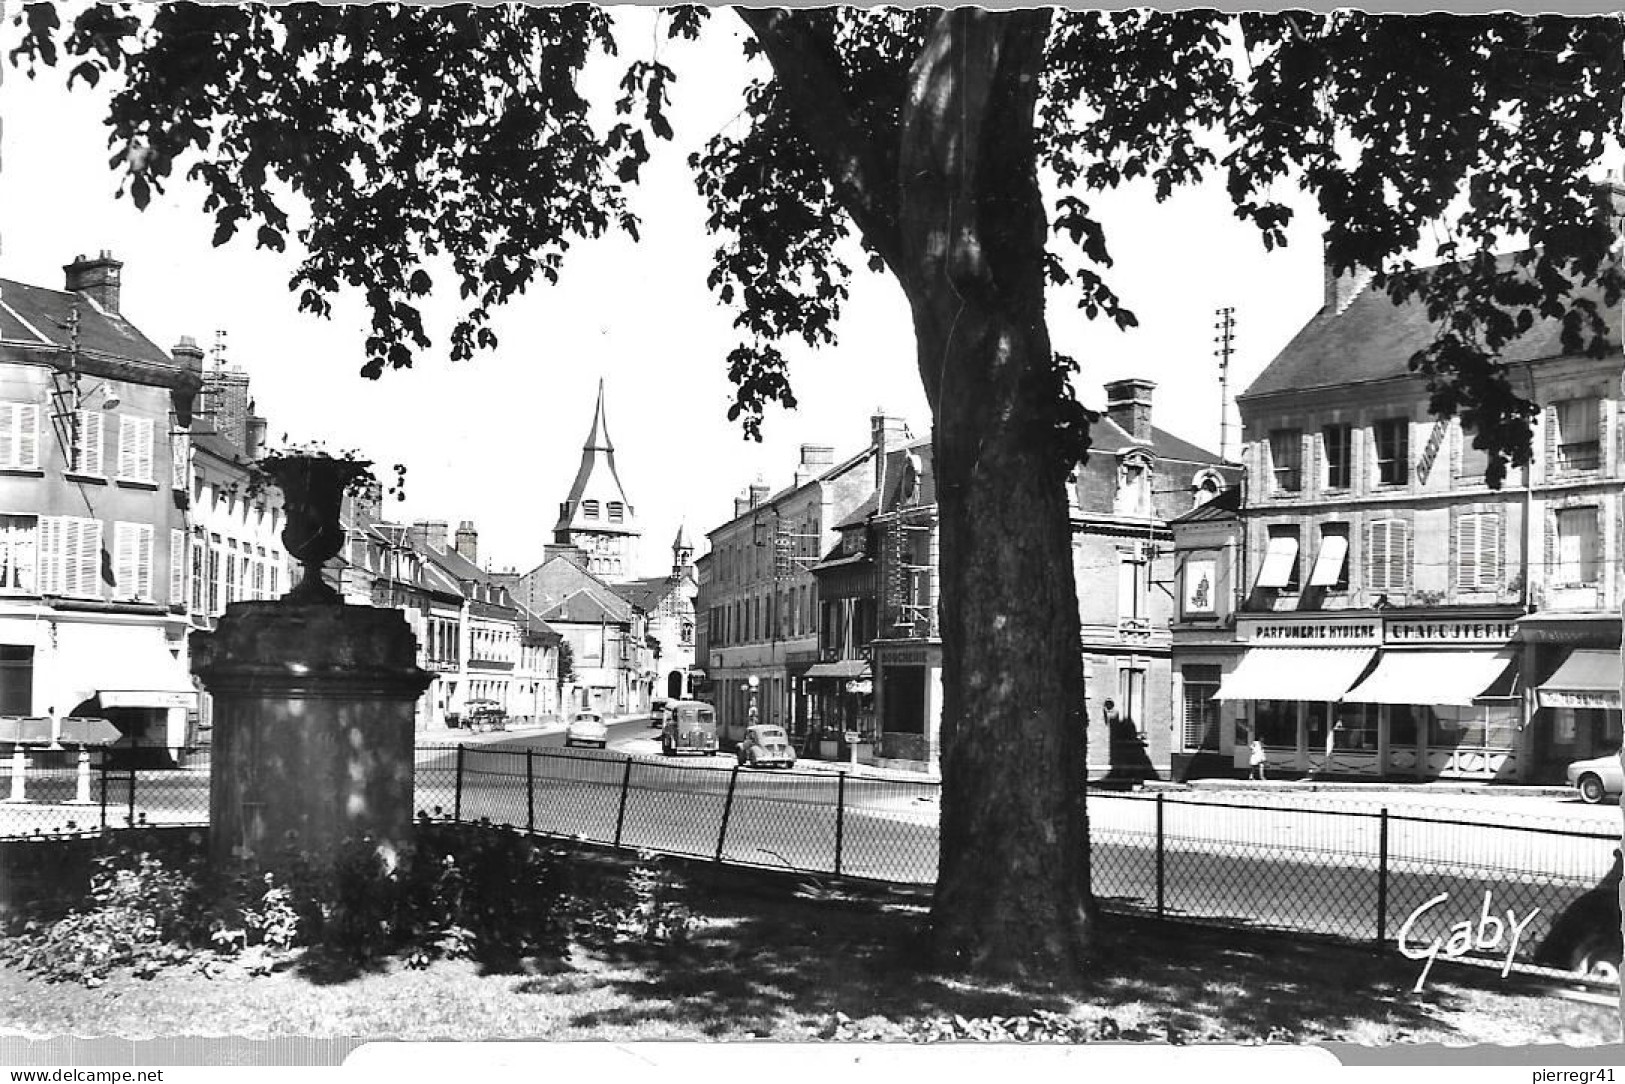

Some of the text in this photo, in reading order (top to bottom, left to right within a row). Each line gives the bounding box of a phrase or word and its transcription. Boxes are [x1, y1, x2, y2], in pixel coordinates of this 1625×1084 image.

[1256, 624, 1375, 638] PARFUMERIE HYGIENE
[1392, 623, 1516, 638] CHARCUTERIE
